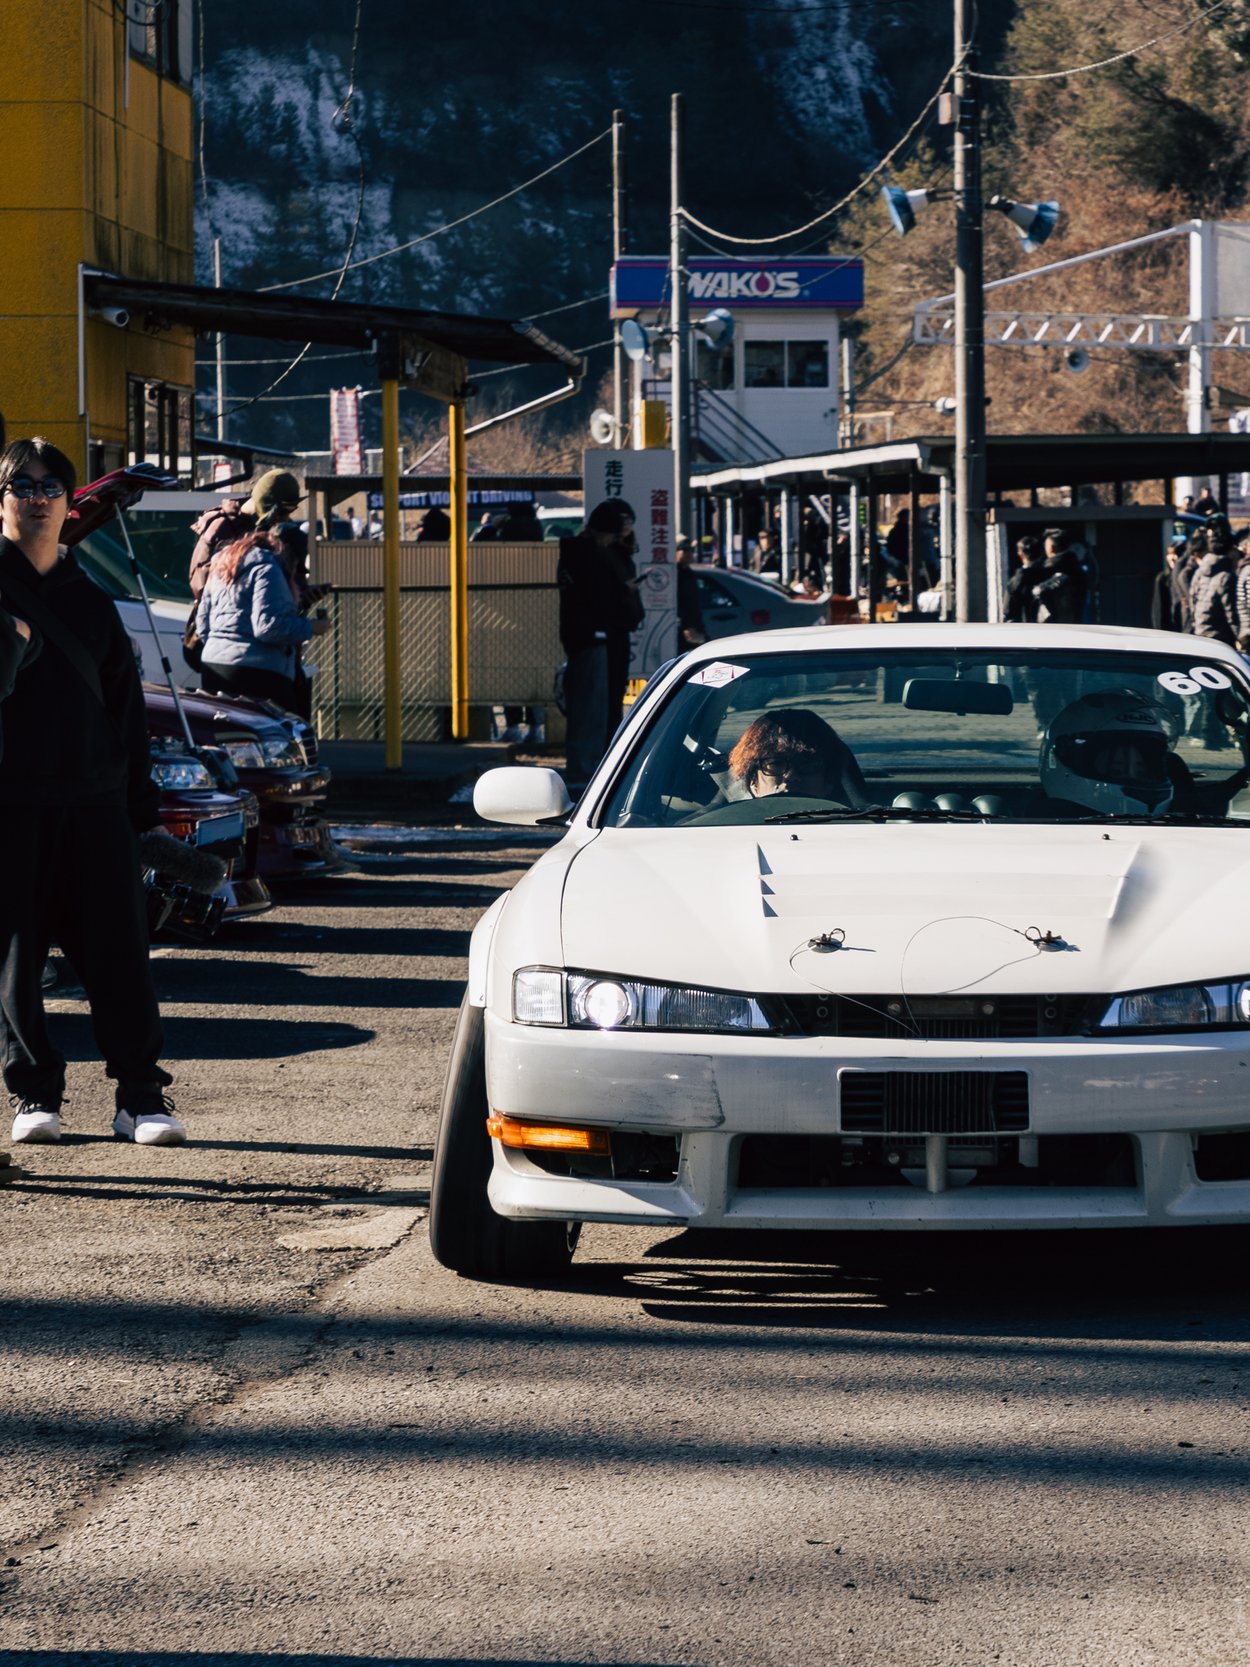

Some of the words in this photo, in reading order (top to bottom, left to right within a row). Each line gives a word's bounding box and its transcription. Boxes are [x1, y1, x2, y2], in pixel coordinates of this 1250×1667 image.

[604, 460, 623, 499] 走行
[651, 488, 669, 564] 盗難注意
[1157, 666, 1232, 696] 60
